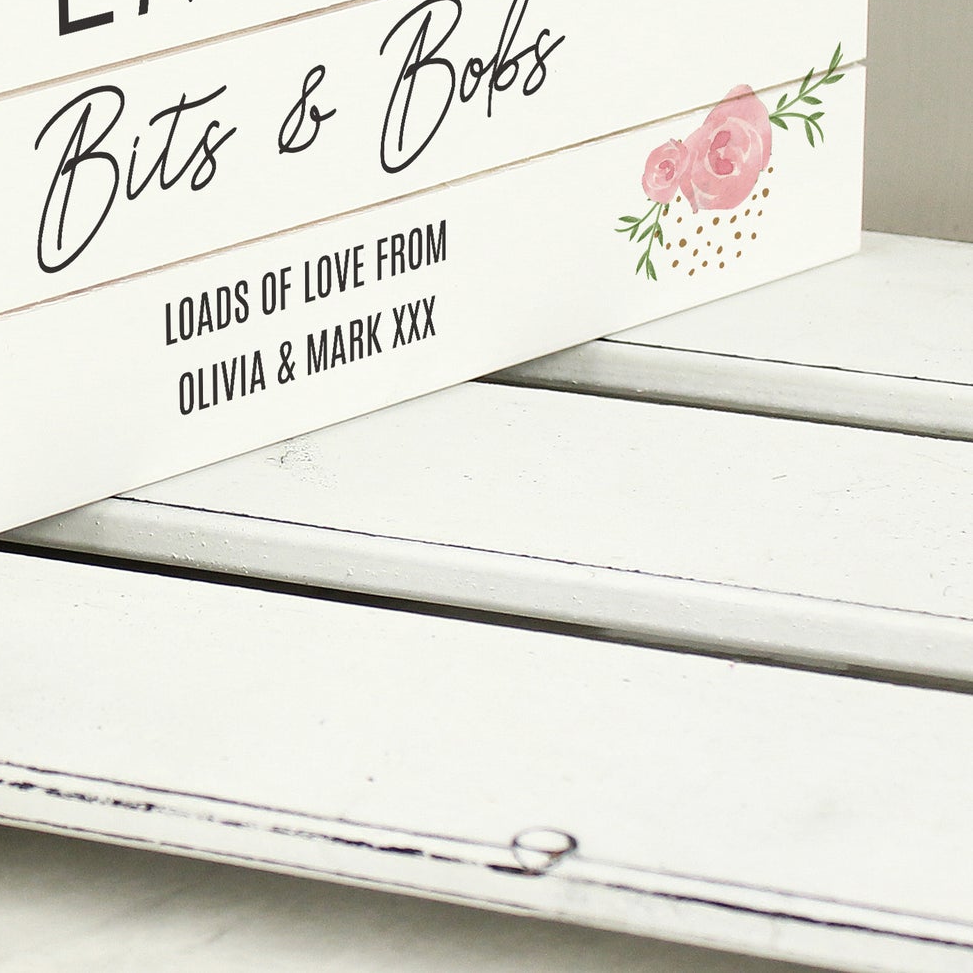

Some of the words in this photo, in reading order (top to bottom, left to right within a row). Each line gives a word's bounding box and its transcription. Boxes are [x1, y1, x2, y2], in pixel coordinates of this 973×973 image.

[34, 84, 238, 274] Bits
[277, 64, 337, 155] &
[165, 280, 250, 347] LOADS
[261, 266, 292, 317] OF
[304, 244, 365, 304] LOVE
[377, 219, 448, 281] FROM
[179, 350, 266, 416] OLIVIA
[277, 340, 297, 385] &
[307, 311, 383, 376] MARK
[392, 295, 436, 349] XXX
